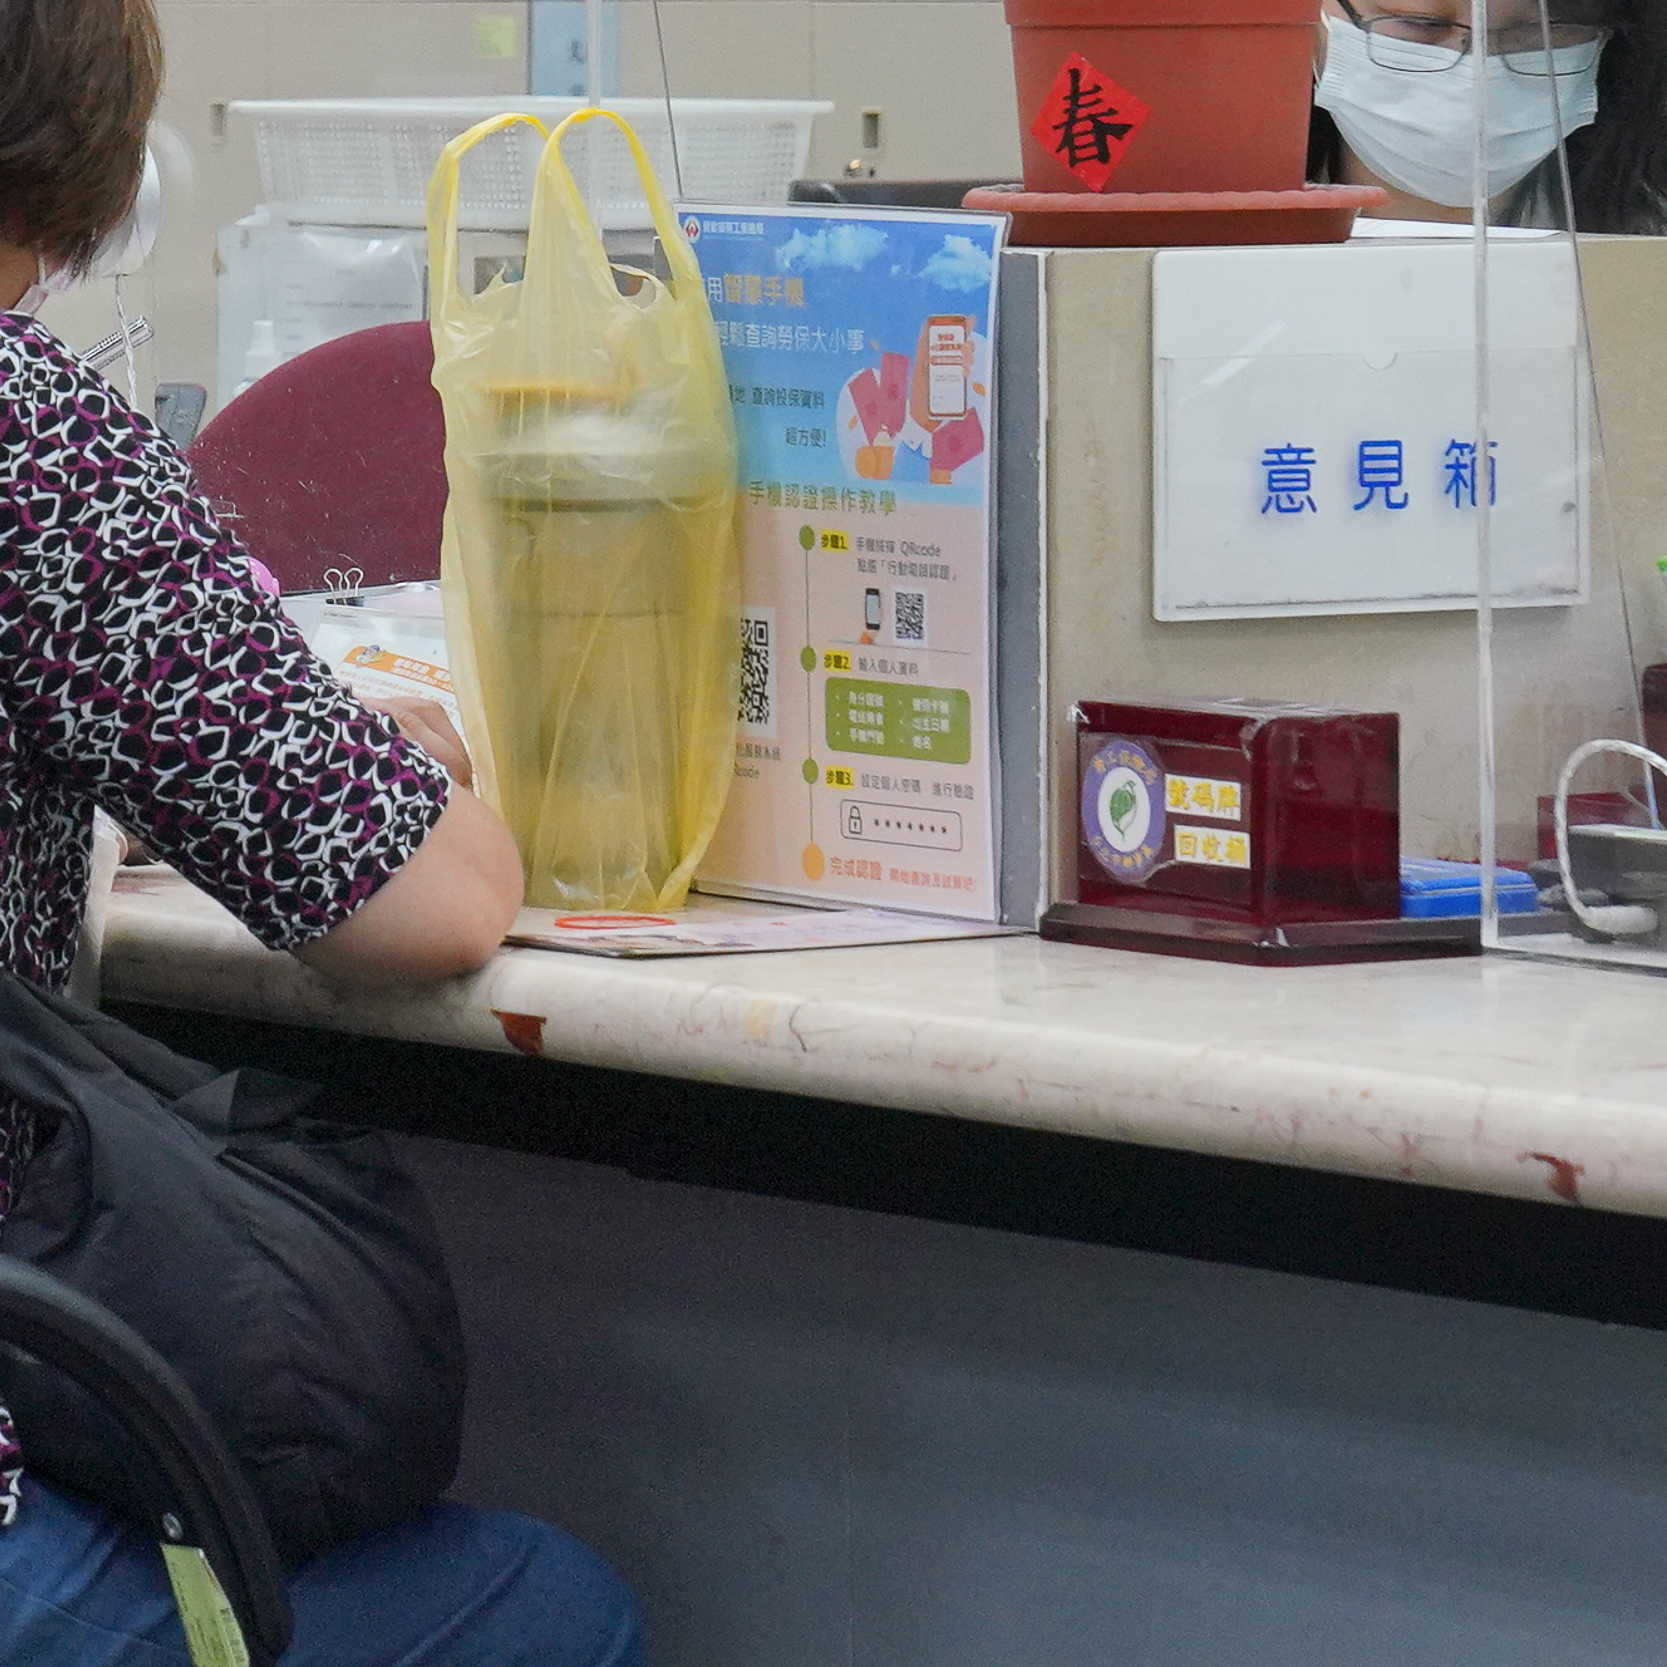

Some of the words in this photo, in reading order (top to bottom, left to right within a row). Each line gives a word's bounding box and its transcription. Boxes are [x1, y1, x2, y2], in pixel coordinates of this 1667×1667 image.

[1052, 67, 1134, 168] 春
[785, 426, 827, 448] 超方便!
[749, 480, 897, 516] 手機認證操作教學
[1261, 438, 1499, 514] 意見箱
